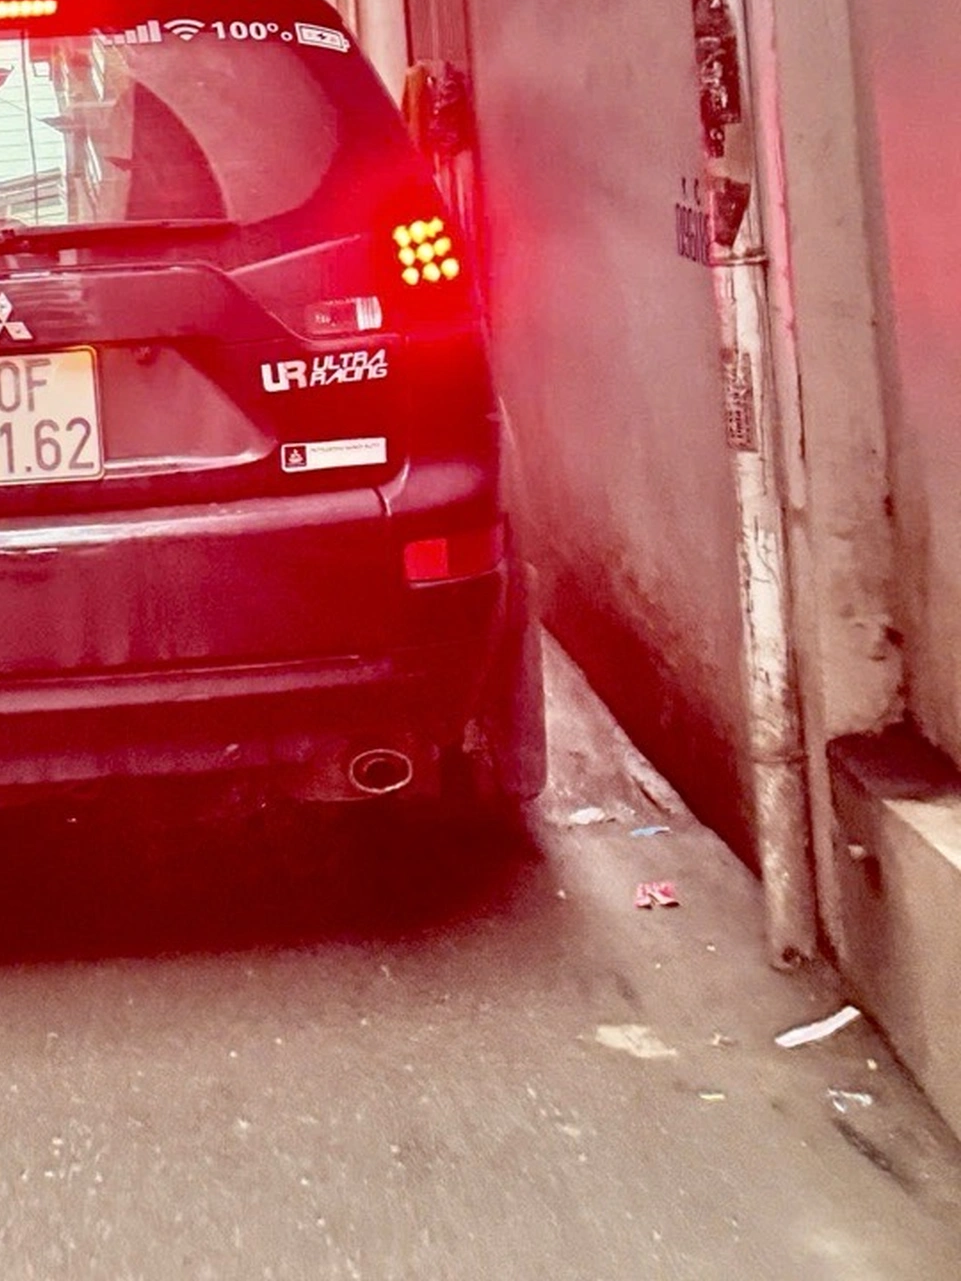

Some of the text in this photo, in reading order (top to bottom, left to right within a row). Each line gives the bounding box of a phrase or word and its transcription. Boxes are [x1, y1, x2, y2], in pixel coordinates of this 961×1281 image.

[261, 349, 386, 392] UR ULTRA
[309, 363, 388, 387] RACING
